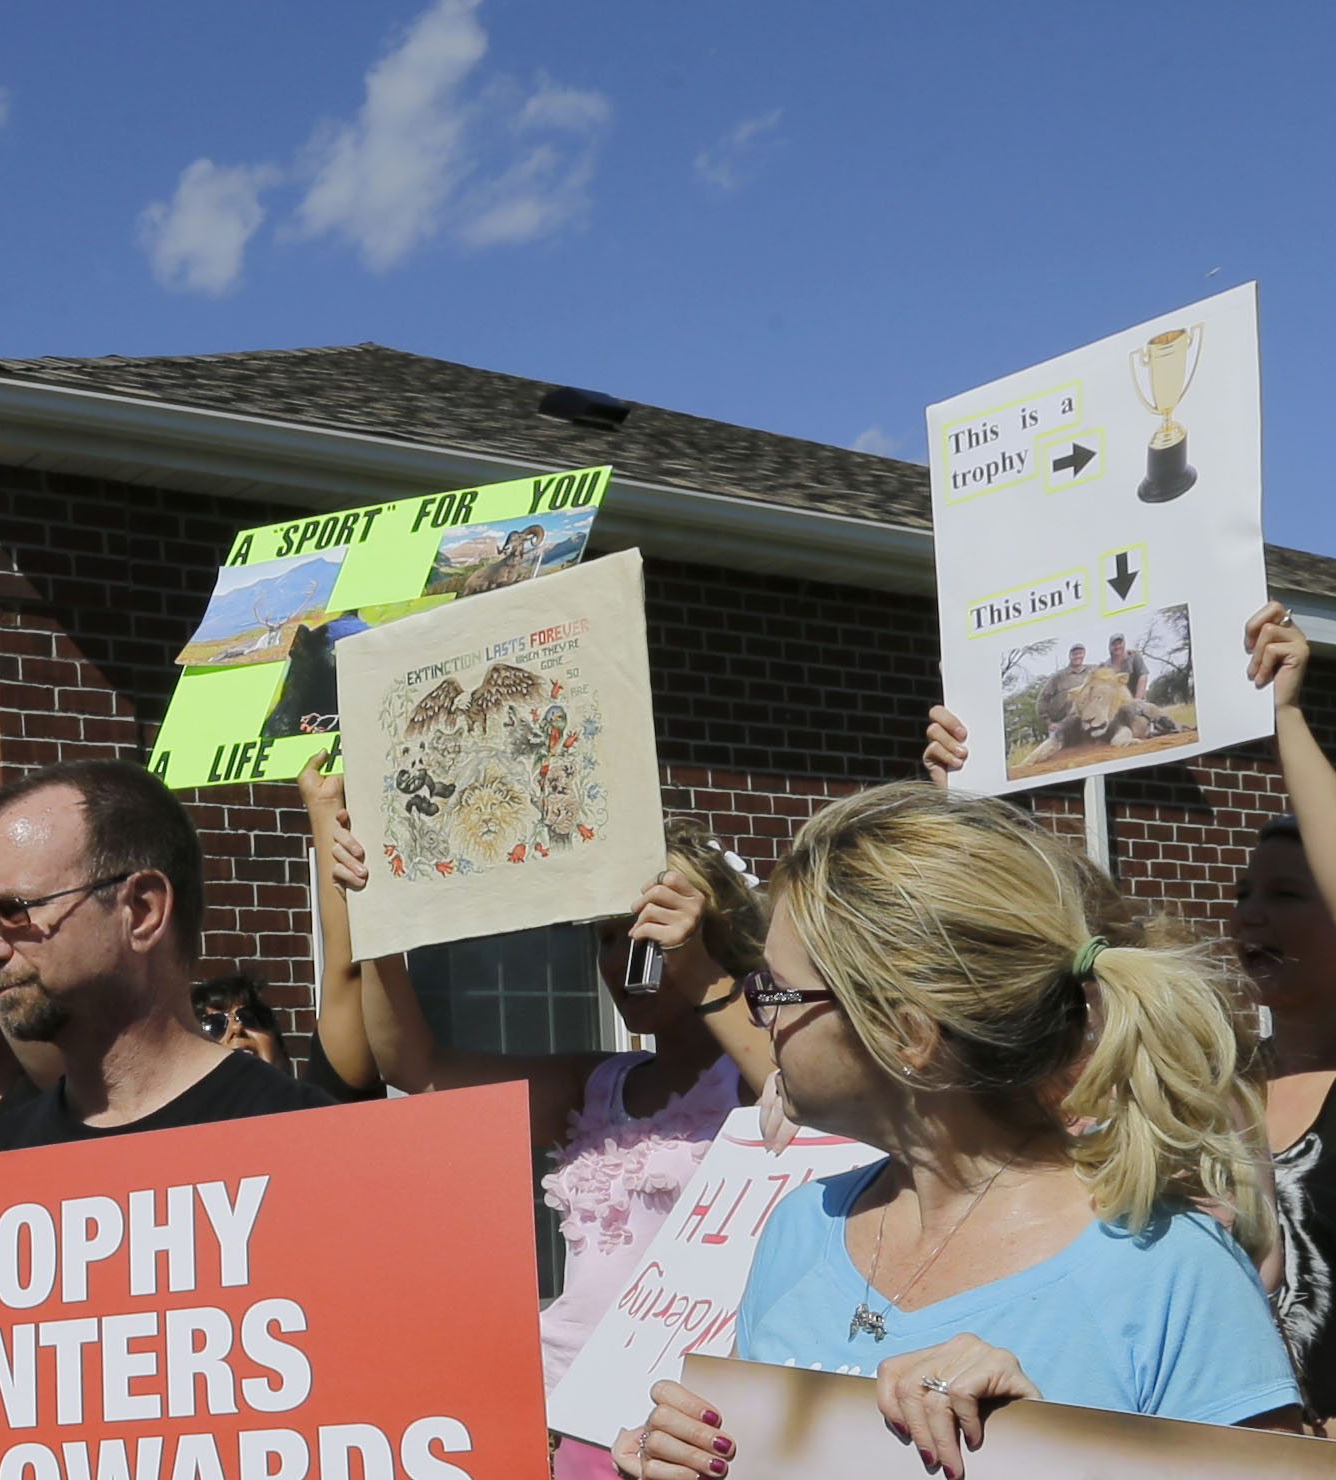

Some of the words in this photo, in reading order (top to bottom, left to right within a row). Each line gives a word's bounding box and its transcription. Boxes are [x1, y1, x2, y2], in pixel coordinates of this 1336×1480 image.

[948, 422, 1000, 456] This
[1020, 404, 1039, 431] is
[1060, 394, 1075, 416] a
[951, 446, 1029, 490] trophy
[230, 533, 255, 567] A
[410, 490, 479, 534] FOR
[528, 470, 603, 515] YOU
[970, 602, 1022, 631] This
[1029, 579, 1083, 614] isn't
[407, 650, 483, 687] EXTINCTION
[485, 635, 526, 663] LASTS
[529, 617, 591, 648] FOREVER
[208, 737, 276, 783] LIFE
